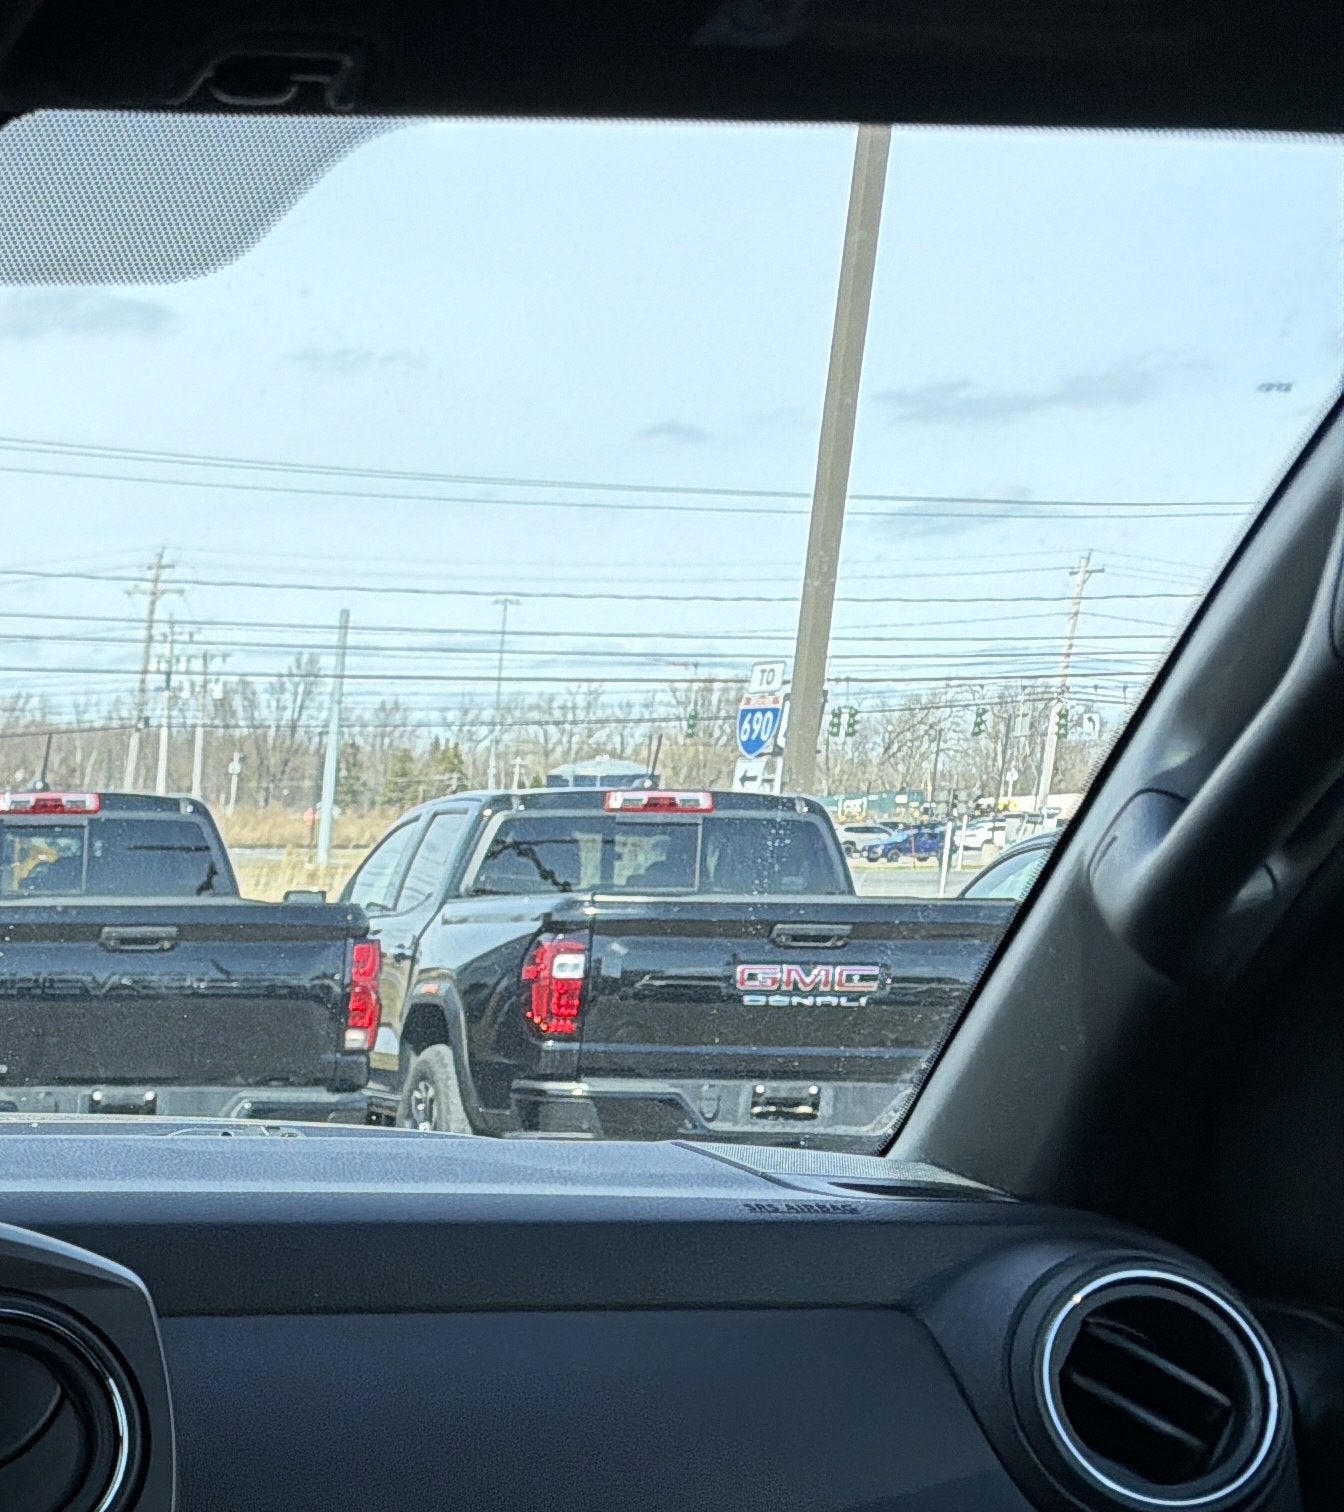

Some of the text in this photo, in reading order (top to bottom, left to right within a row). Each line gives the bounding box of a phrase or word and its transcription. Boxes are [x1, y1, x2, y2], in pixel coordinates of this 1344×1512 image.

[759, 668, 776, 687] TO
[740, 710, 774, 742] 690
[735, 964, 880, 992] GMC
[742, 994, 869, 1007] DENALI
[785, 1203, 860, 1215] AIRBAG
